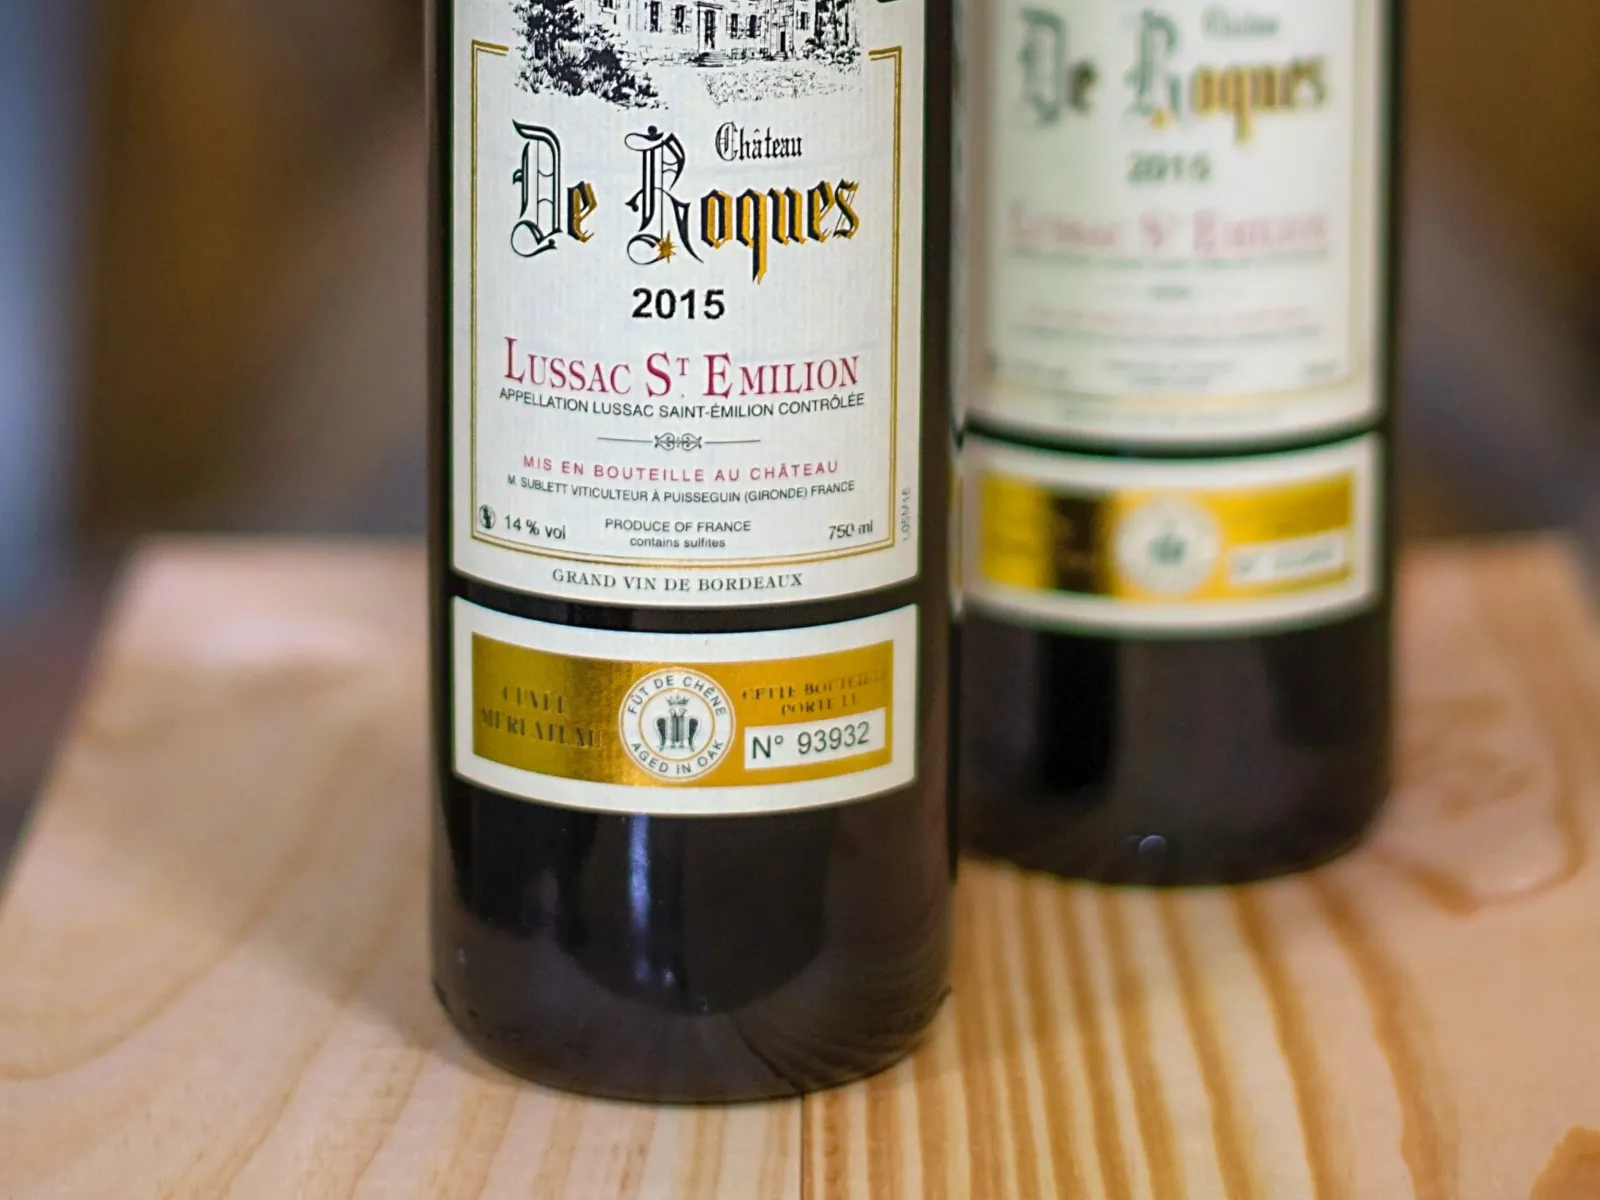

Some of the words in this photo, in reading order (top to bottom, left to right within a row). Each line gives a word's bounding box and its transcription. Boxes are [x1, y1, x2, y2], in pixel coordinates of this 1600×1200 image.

[715, 121, 803, 161] Château
[510, 118, 598, 258] De
[624, 125, 861, 285] Roques
[631, 288, 726, 320] 2015
[503, 336, 632, 395] LUSSAC
[702, 351, 859, 399] EMILION
[499, 387, 588, 413] APPELLATION
[592, 402, 654, 418] LUSSAC
[659, 402, 774, 419] SAINT-ÉMILION
[778, 392, 865, 415] CONTRÔLÉE
[523, 455, 552, 471] MIS
[562, 461, 584, 475] EN
[594, 464, 704, 482] BOUTEILLE
[715, 469, 739, 482] AU
[750, 460, 838, 481] CHÂTEAU
[520, 476, 568, 495] SUBLETT
[571, 485, 648, 502] VITICULTEUR
[664, 491, 741, 504] PUISSEGUIN
[744, 486, 807, 504] (GIRONDE)
[811, 480, 855, 497] FRANCE
[505, 515, 522, 532] 14
[526, 519, 540, 536] %
[544, 525, 566, 540] vol
[605, 518, 670, 532] PRODUCE
[675, 521, 692, 532] OF
[697, 520, 751, 532] FRANCE
[828, 523, 854, 540] 750
[858, 519, 873, 534] ml
[629, 536, 679, 548] contains
[684, 537, 726, 548] sulfites
[552, 568, 616, 588] GRAND
[623, 575, 656, 591] VIN
[664, 578, 690, 591] DE
[699, 573, 803, 591] BORDEAUX
[653, 675, 674, 689] DE
[752, 734, 784, 760] N°
[797, 721, 870, 755] 93932
[631, 741, 669, 773] AGED
[676, 763, 691, 775] IN
[697, 740, 724, 767] OAK
